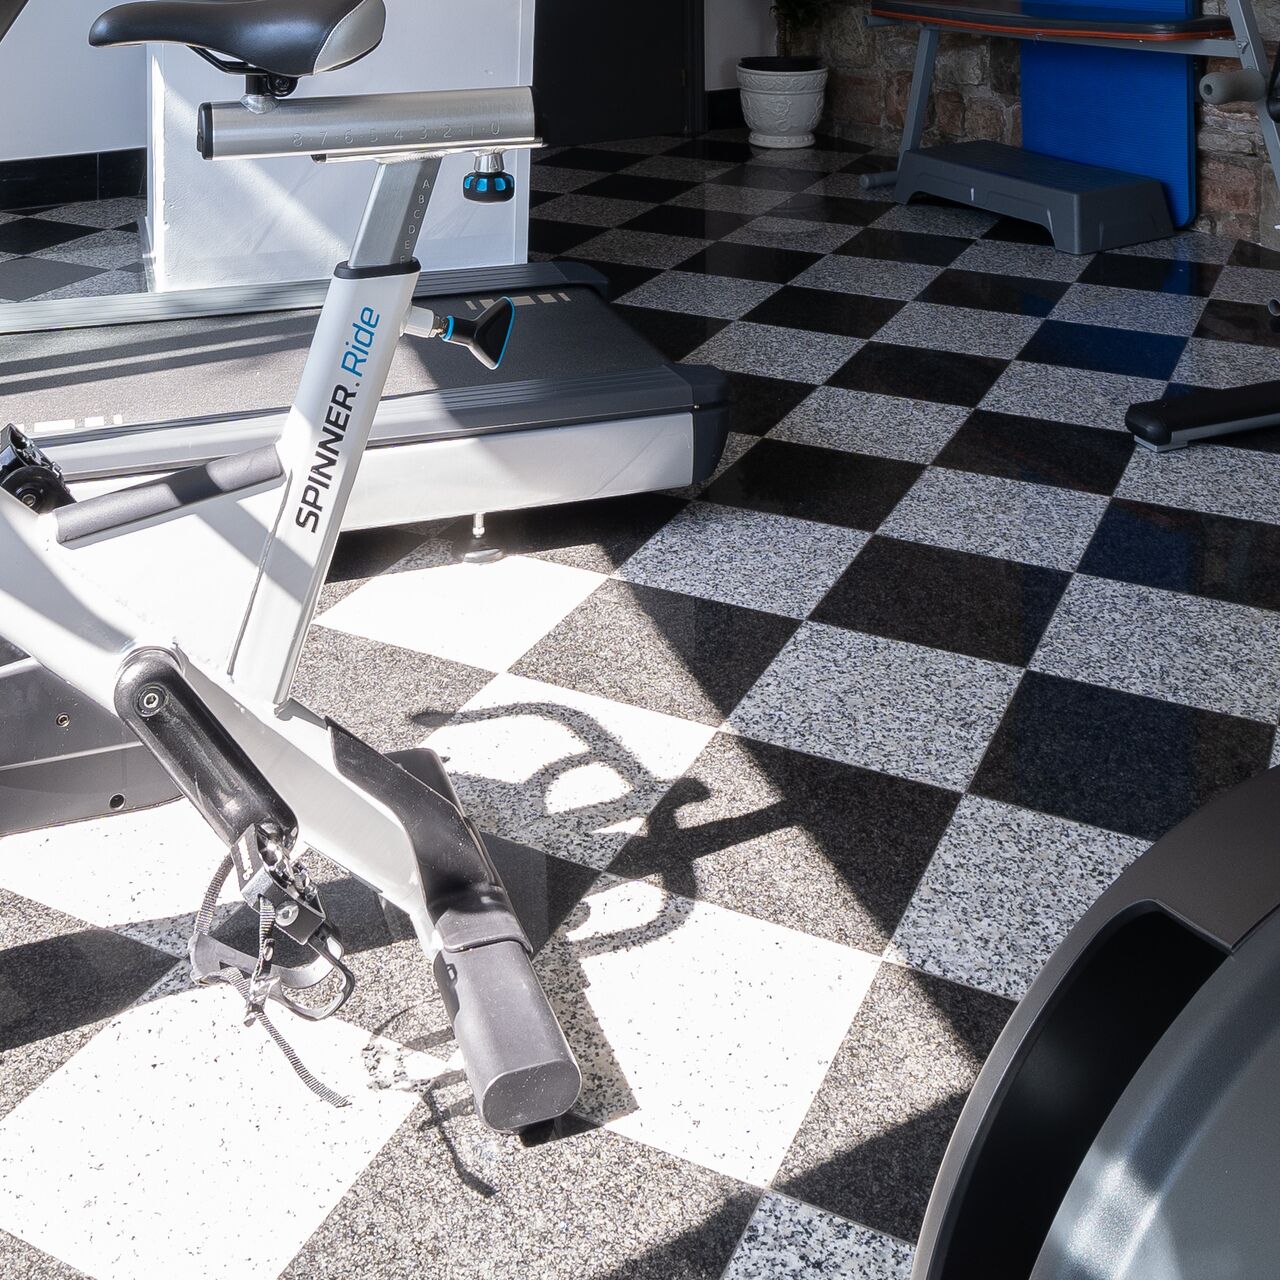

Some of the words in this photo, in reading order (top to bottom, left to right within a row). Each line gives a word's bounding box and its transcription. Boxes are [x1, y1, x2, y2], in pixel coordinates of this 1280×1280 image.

[422, 179, 431, 190] A
[418, 194, 425, 204] B
[413, 209, 421, 220] C
[408, 224, 416, 235] D
[404, 239, 411, 250] E
[341, 306, 381, 378] Ride
